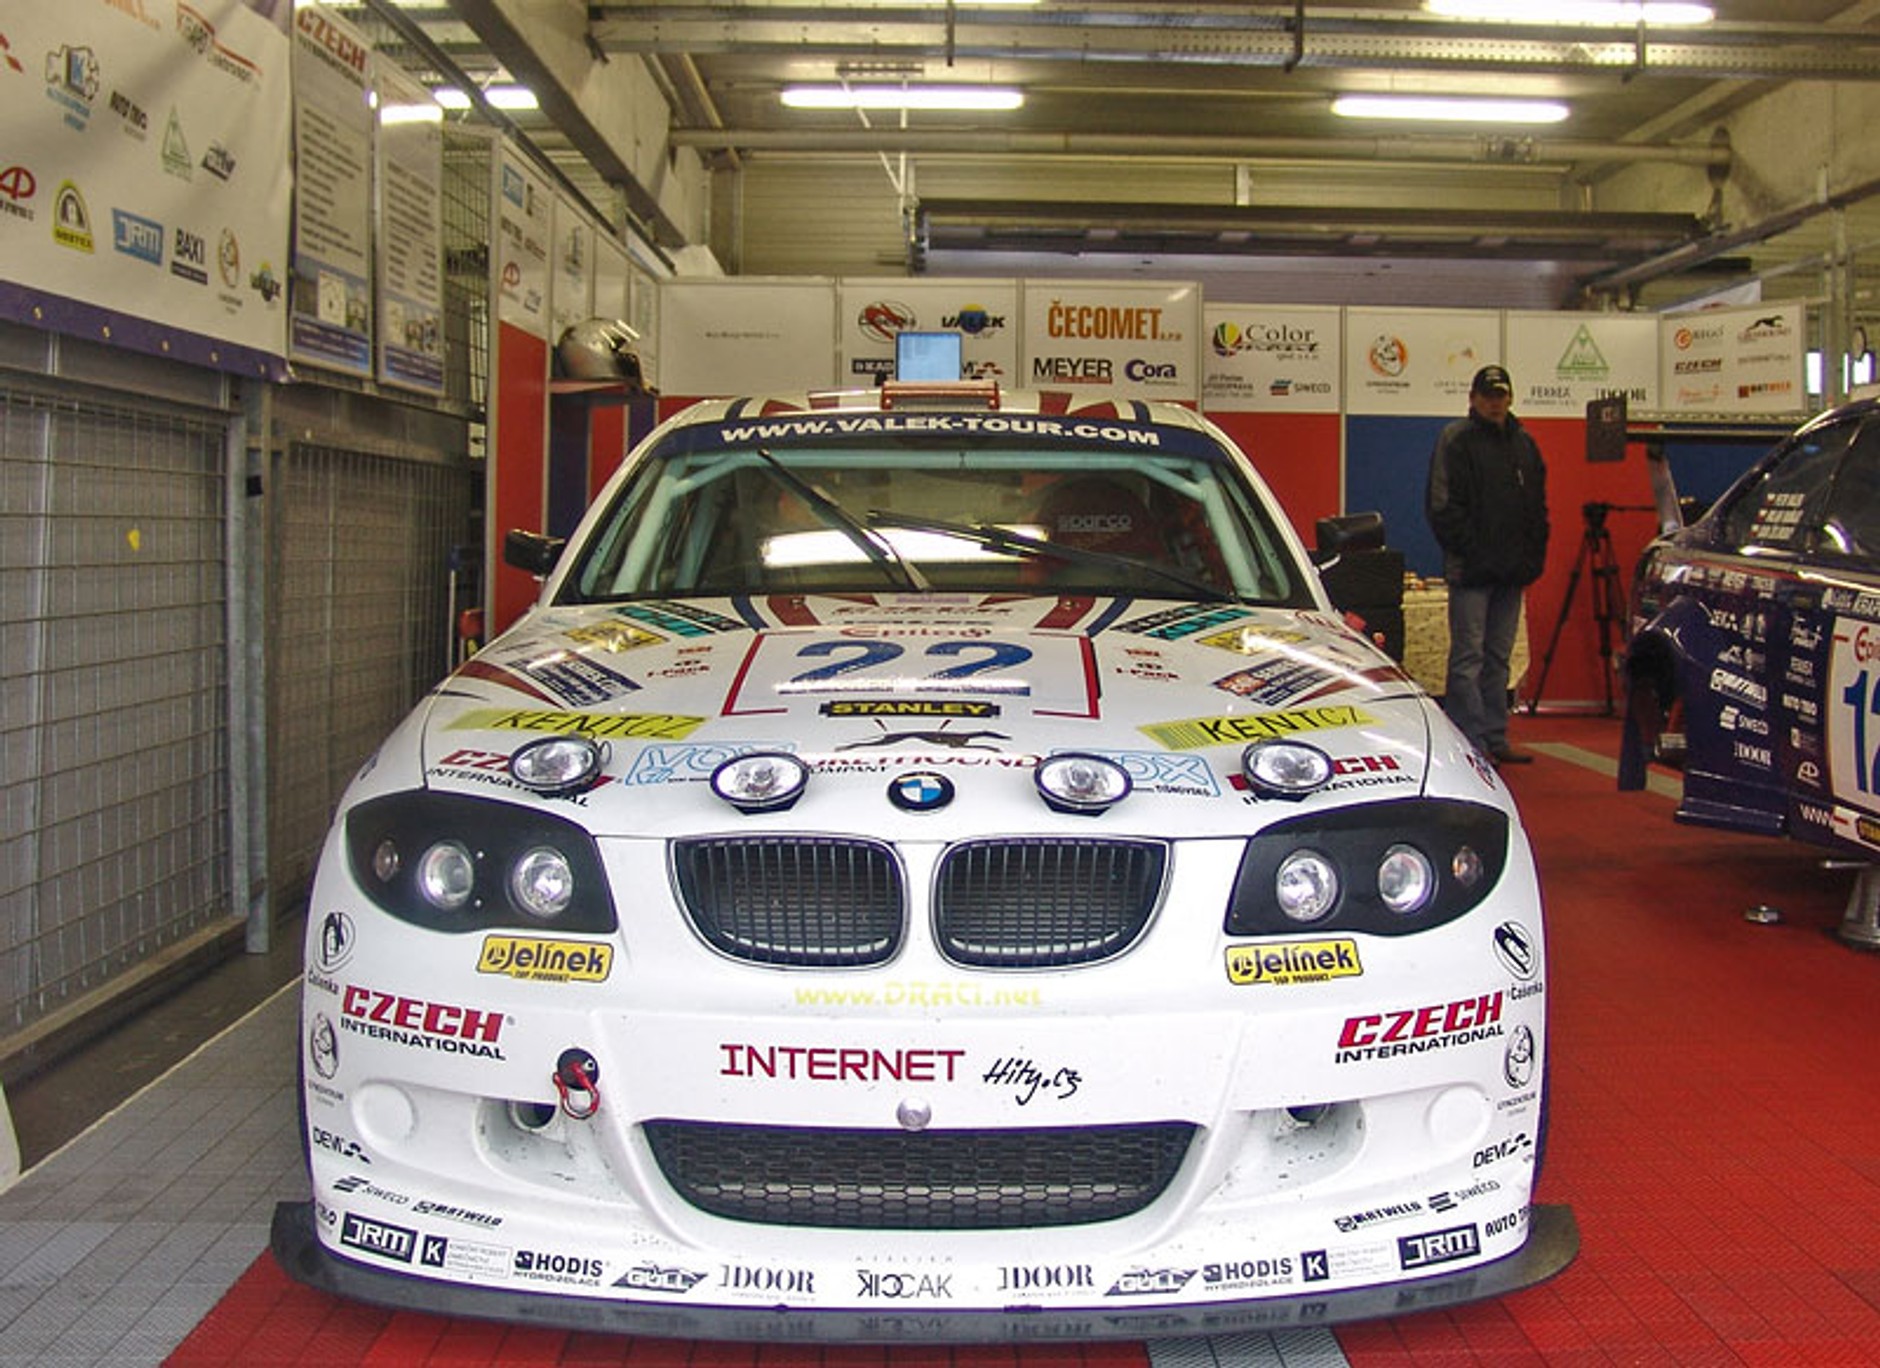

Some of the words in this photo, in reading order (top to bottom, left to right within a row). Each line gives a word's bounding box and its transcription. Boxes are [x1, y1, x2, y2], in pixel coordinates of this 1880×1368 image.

[297, 8, 366, 74] CZECH
[176, 228, 205, 265] BAXI
[1048, 300, 1162, 340] ČECOMET
[1245, 324, 1315, 342] Color
[1033, 357, 1113, 378] MEYER
[1125, 359, 1177, 383] Cora
[721, 416, 1161, 447] WWW.VALEK-TOUR.COM
[789, 640, 1034, 686] 22
[832, 702, 989, 715] STANLEY
[342, 984, 505, 1043] CZECH
[1337, 990, 1504, 1049] CZECH
[340, 1016, 507, 1062] INTERNATIONAL
[1334, 1022, 1505, 1064] INTERNATIONAL
[719, 1043, 967, 1082] INTERNET
[1485, 1212, 1518, 1238] AUTO
[425, 1239, 442, 1263] K
[535, 1252, 604, 1278] HODIS
[1306, 1254, 1324, 1278] K
[1225, 1257, 1293, 1281] HODIS
